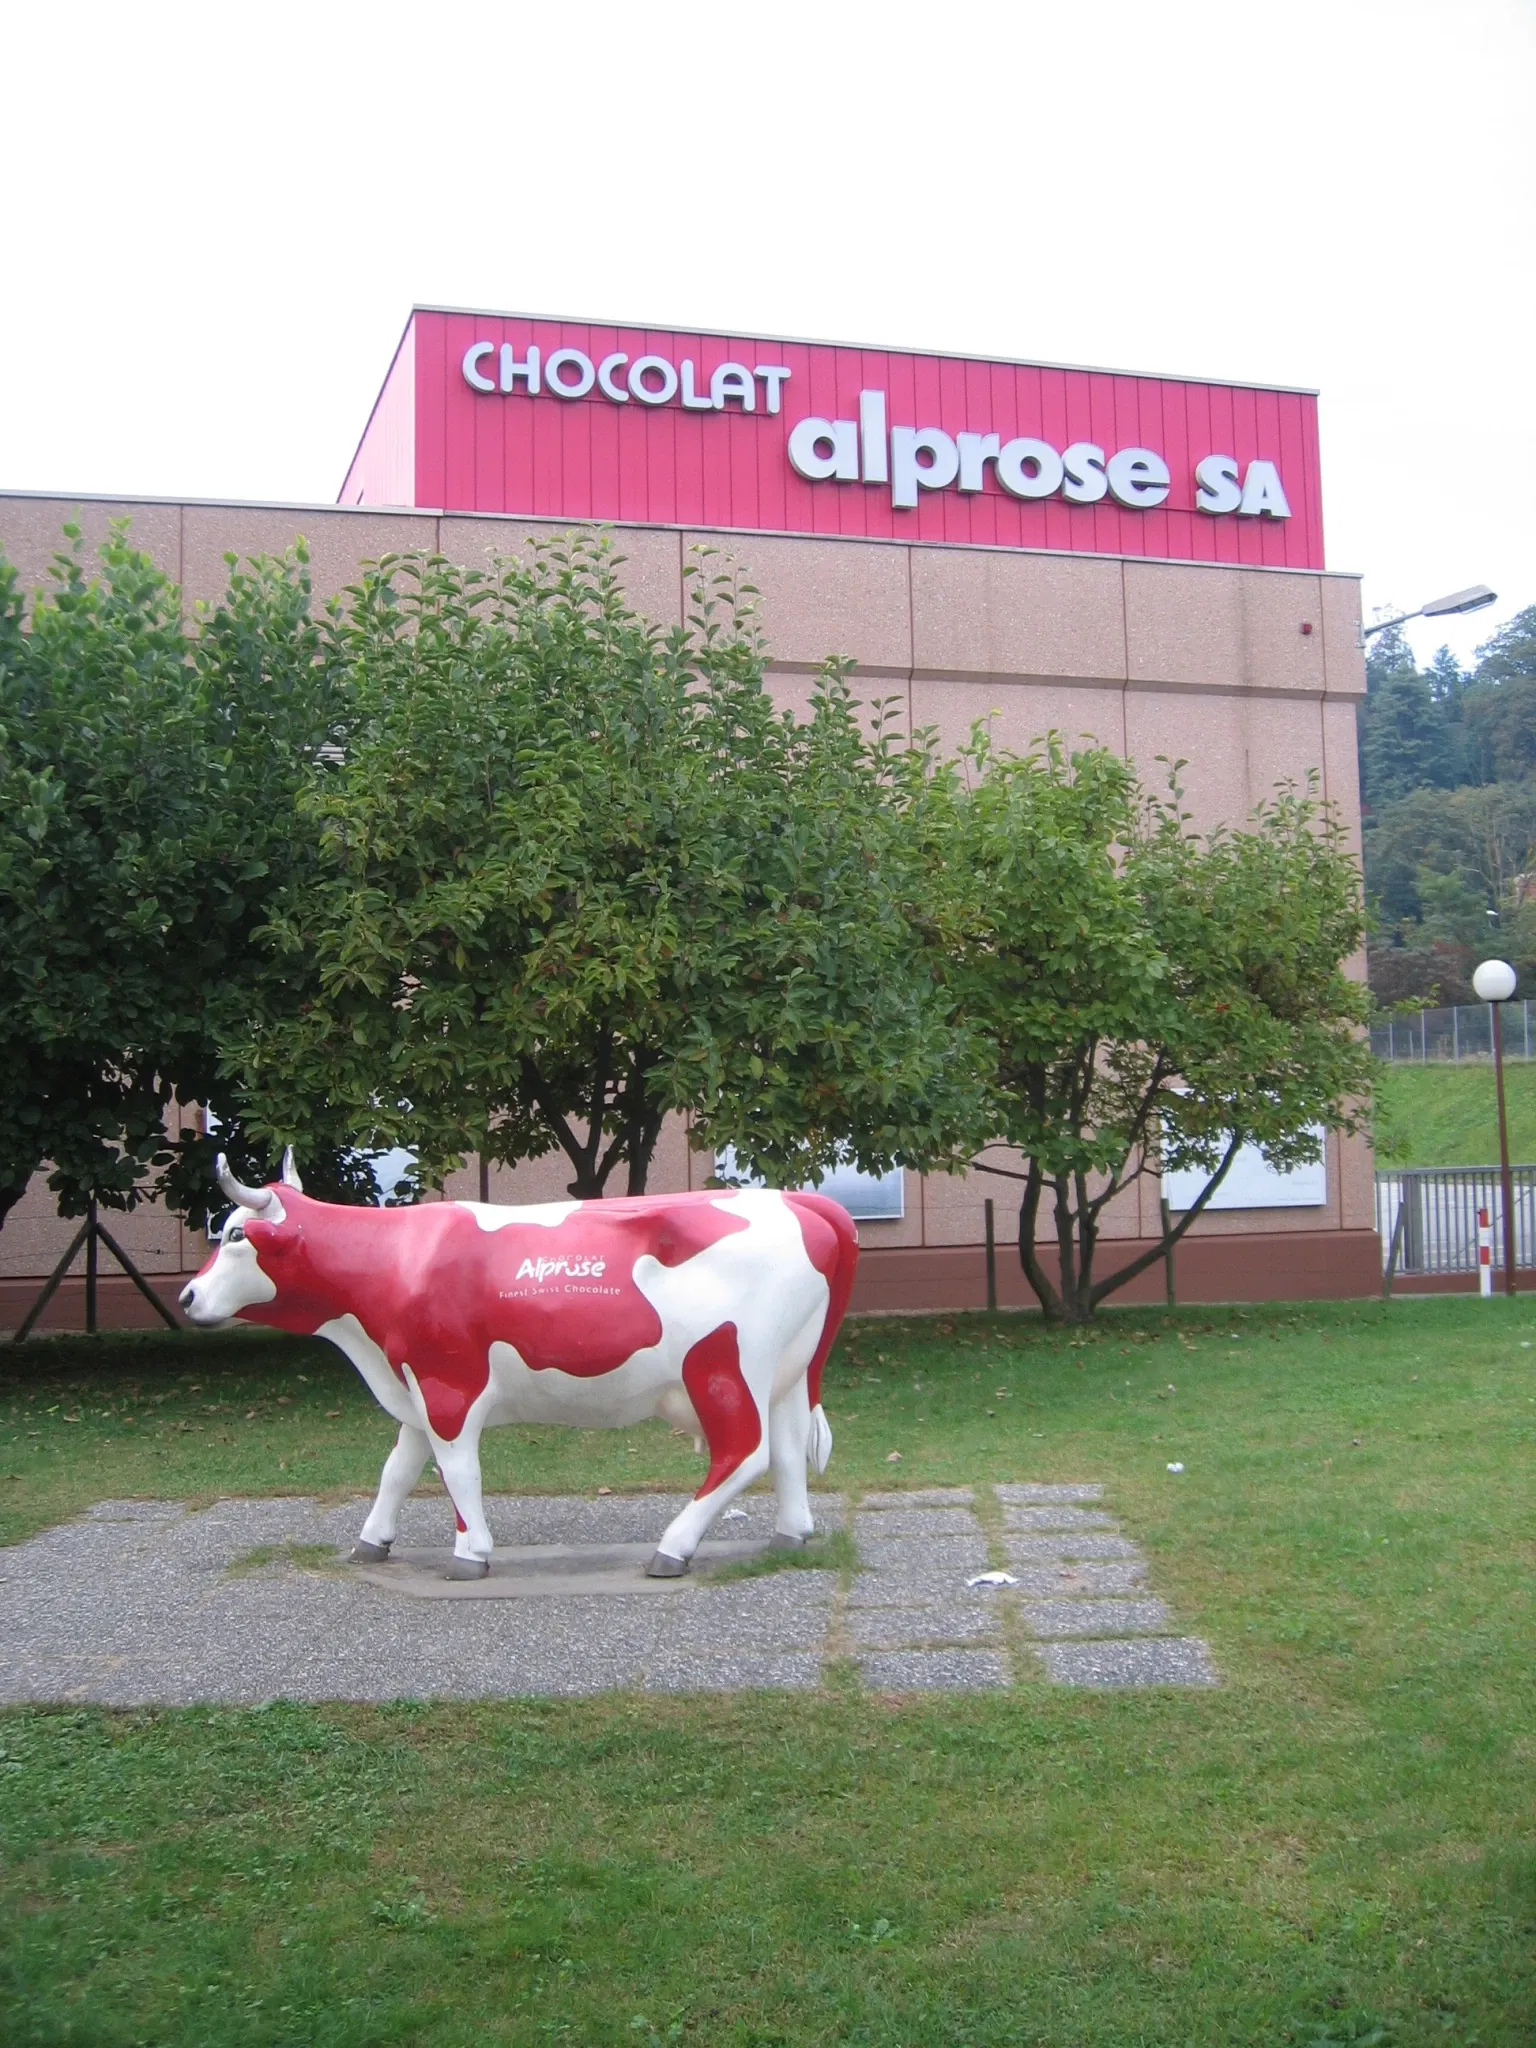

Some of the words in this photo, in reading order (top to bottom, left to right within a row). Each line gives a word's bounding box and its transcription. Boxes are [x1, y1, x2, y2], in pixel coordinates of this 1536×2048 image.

[462, 341, 792, 414] CHOCOLAT
[788, 389, 1171, 509] alprose
[1195, 454, 1292, 519] SA
[564, 1284, 621, 1296] Chocolate
